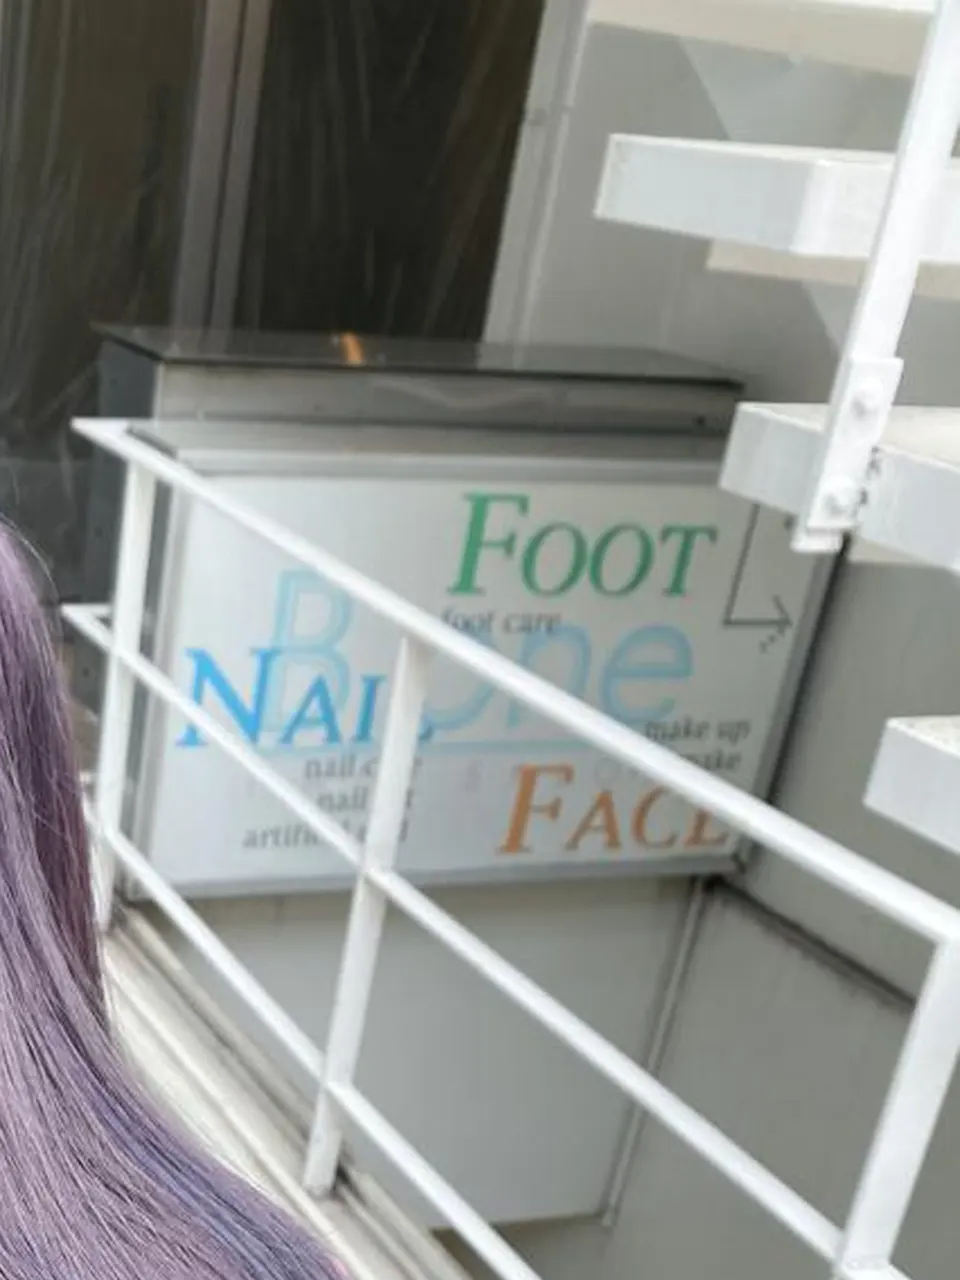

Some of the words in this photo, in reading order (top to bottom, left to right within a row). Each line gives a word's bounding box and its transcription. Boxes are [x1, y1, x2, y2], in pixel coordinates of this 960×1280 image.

[446, 492, 718, 598] FOOT
[441, 605, 496, 634] foot
[503, 612, 563, 635] care
[174, 647, 435, 747] NAI
[305, 753, 357, 779] nail
